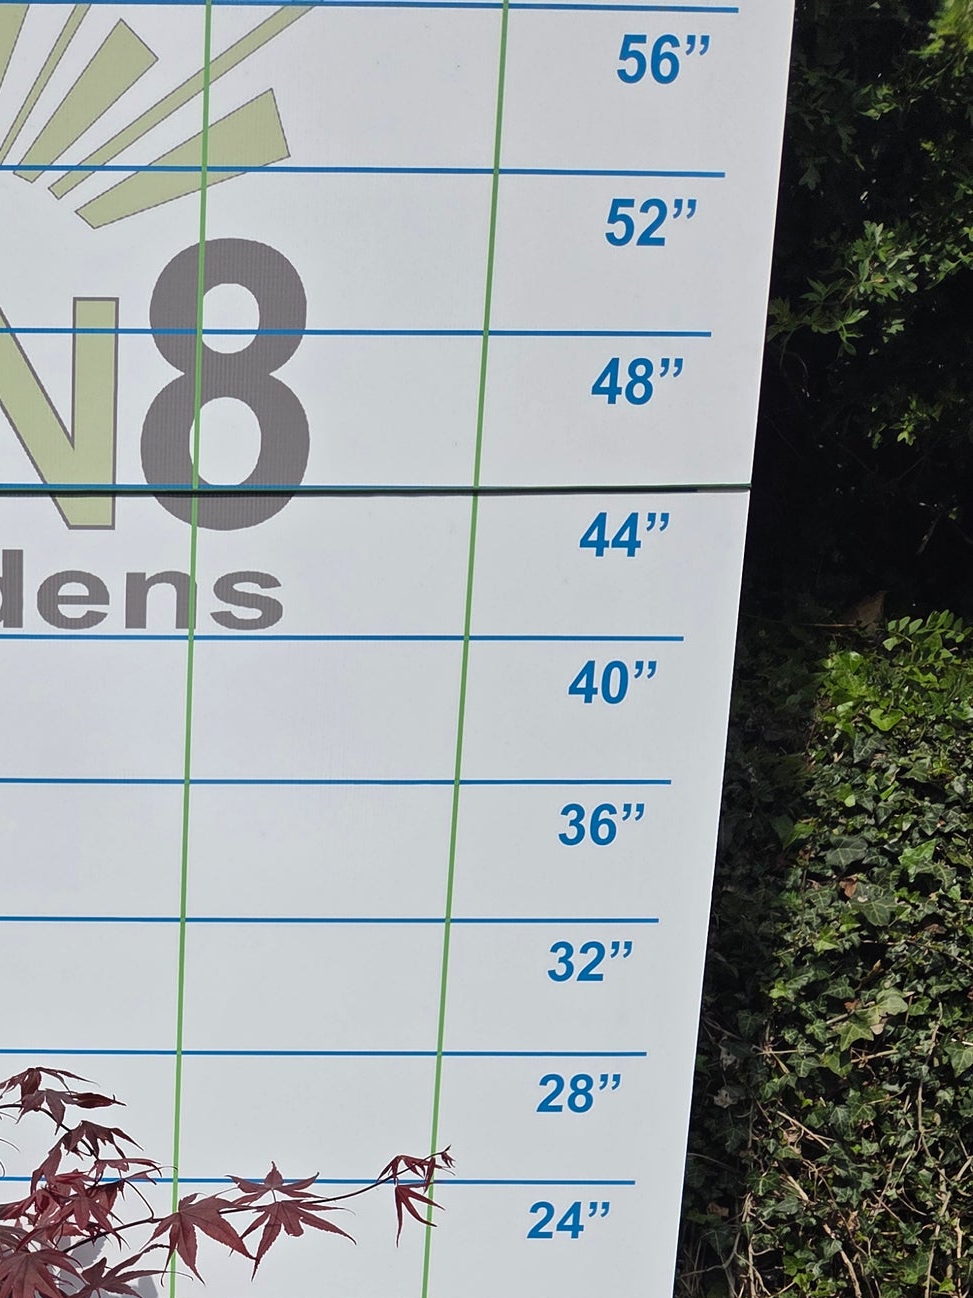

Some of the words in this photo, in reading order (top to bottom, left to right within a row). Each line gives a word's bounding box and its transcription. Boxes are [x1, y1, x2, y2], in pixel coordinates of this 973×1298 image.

[618, 34, 710, 84] 56”
[606, 198, 697, 246] 52”
[591, 357, 683, 405] 48”
[579, 512, 669, 557] 44”
[568, 660, 657, 704] 40”
[558, 803, 644, 846] 36”
[548, 941, 632, 982] 32”
[536, 1074, 621, 1113] 28”
[527, 1201, 610, 1239] 24”
